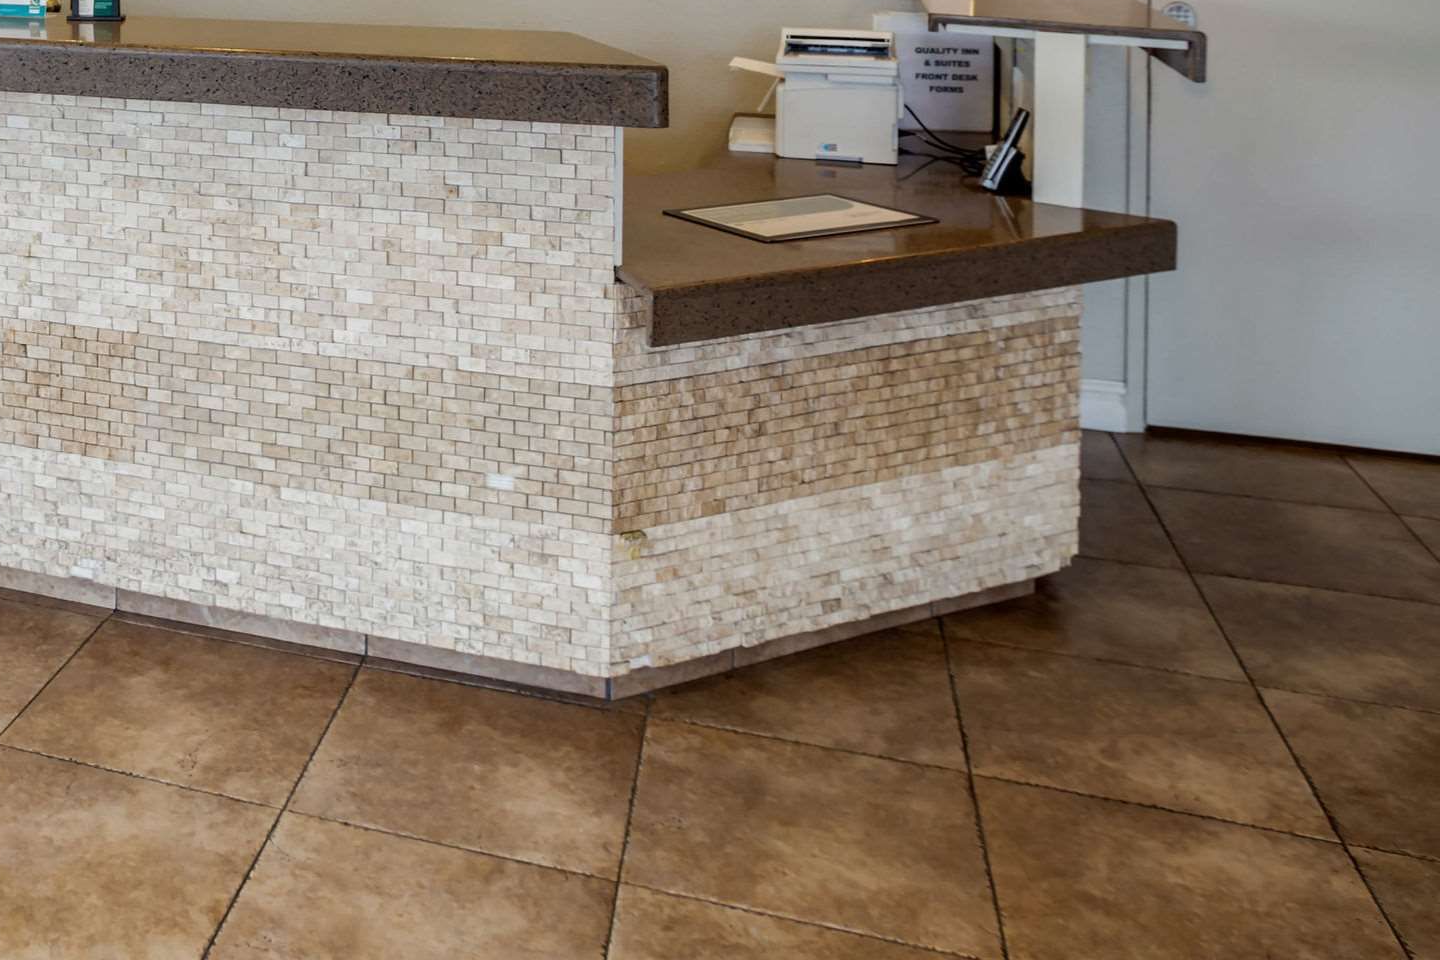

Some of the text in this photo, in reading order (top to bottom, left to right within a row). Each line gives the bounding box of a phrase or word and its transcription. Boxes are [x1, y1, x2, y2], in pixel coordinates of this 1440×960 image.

[914, 47, 959, 55] QUALITY
[951, 73, 978, 81] DESK
[929, 85, 964, 93] FORMS
